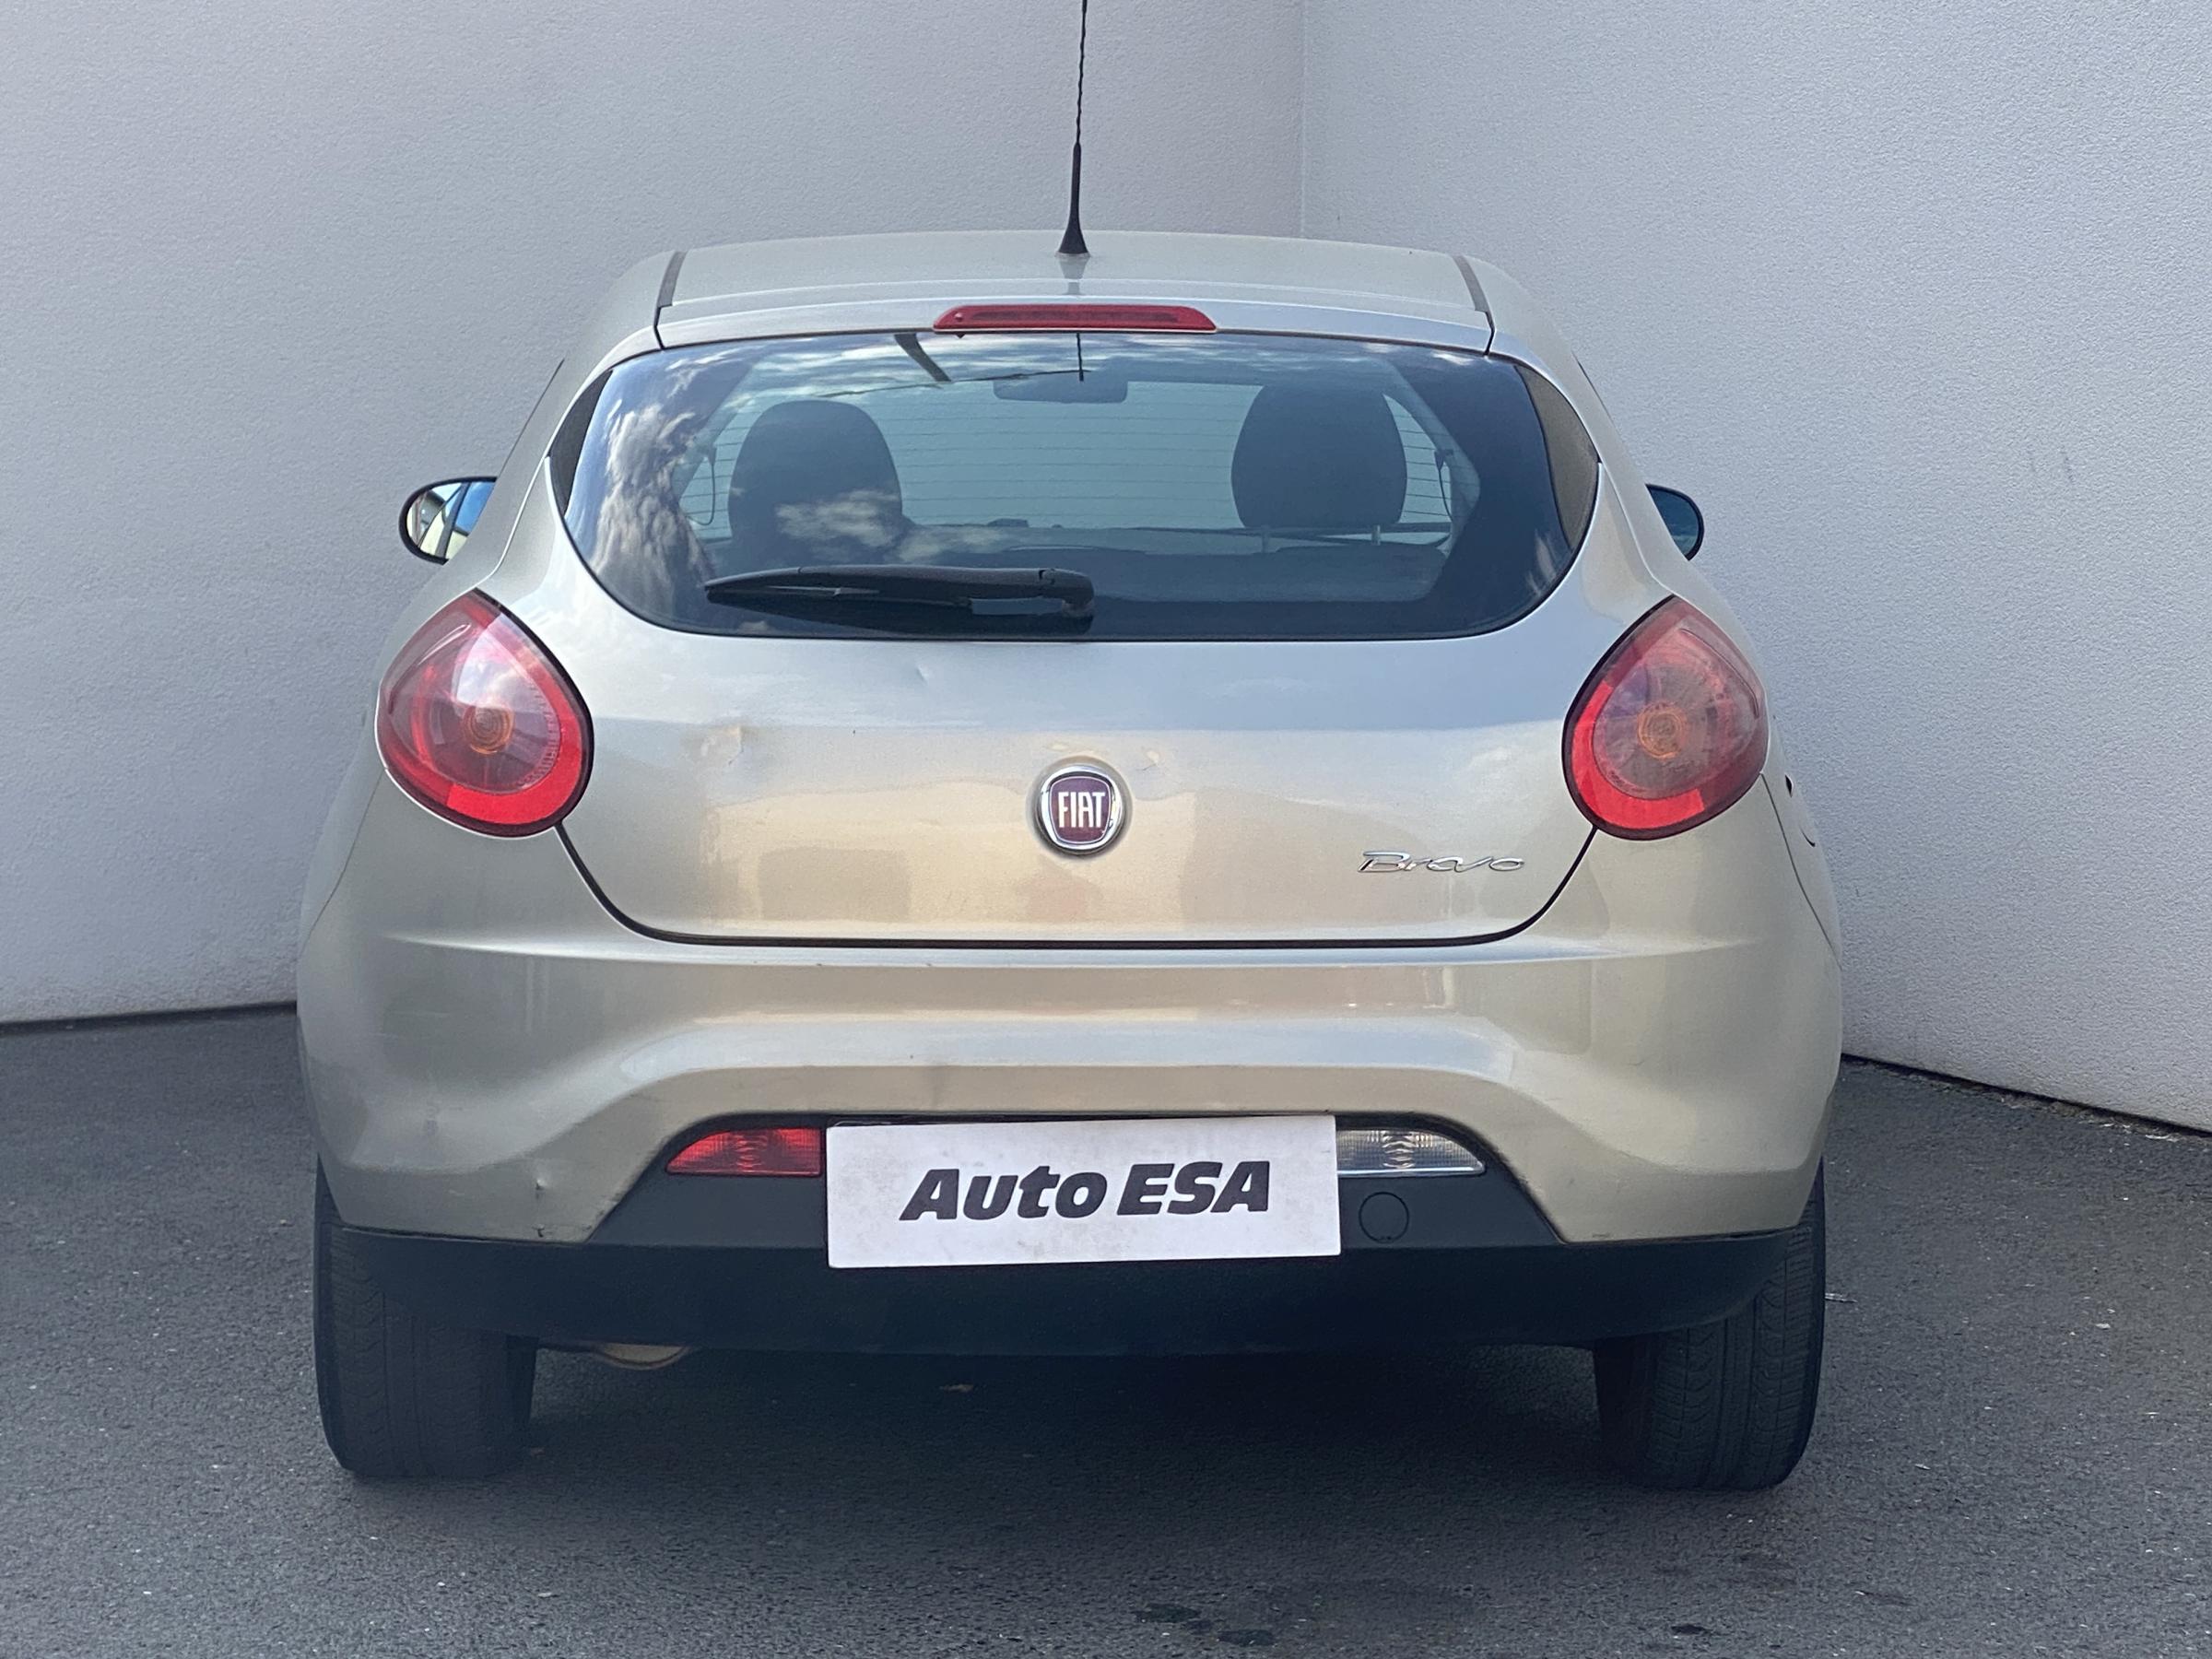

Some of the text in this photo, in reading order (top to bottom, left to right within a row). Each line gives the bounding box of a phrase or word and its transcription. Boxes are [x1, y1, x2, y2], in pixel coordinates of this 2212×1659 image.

[1058, 791, 1106, 828] FIAT
[1358, 850, 1524, 873] Bravo
[899, 1160, 1270, 1221] Auto ESA
